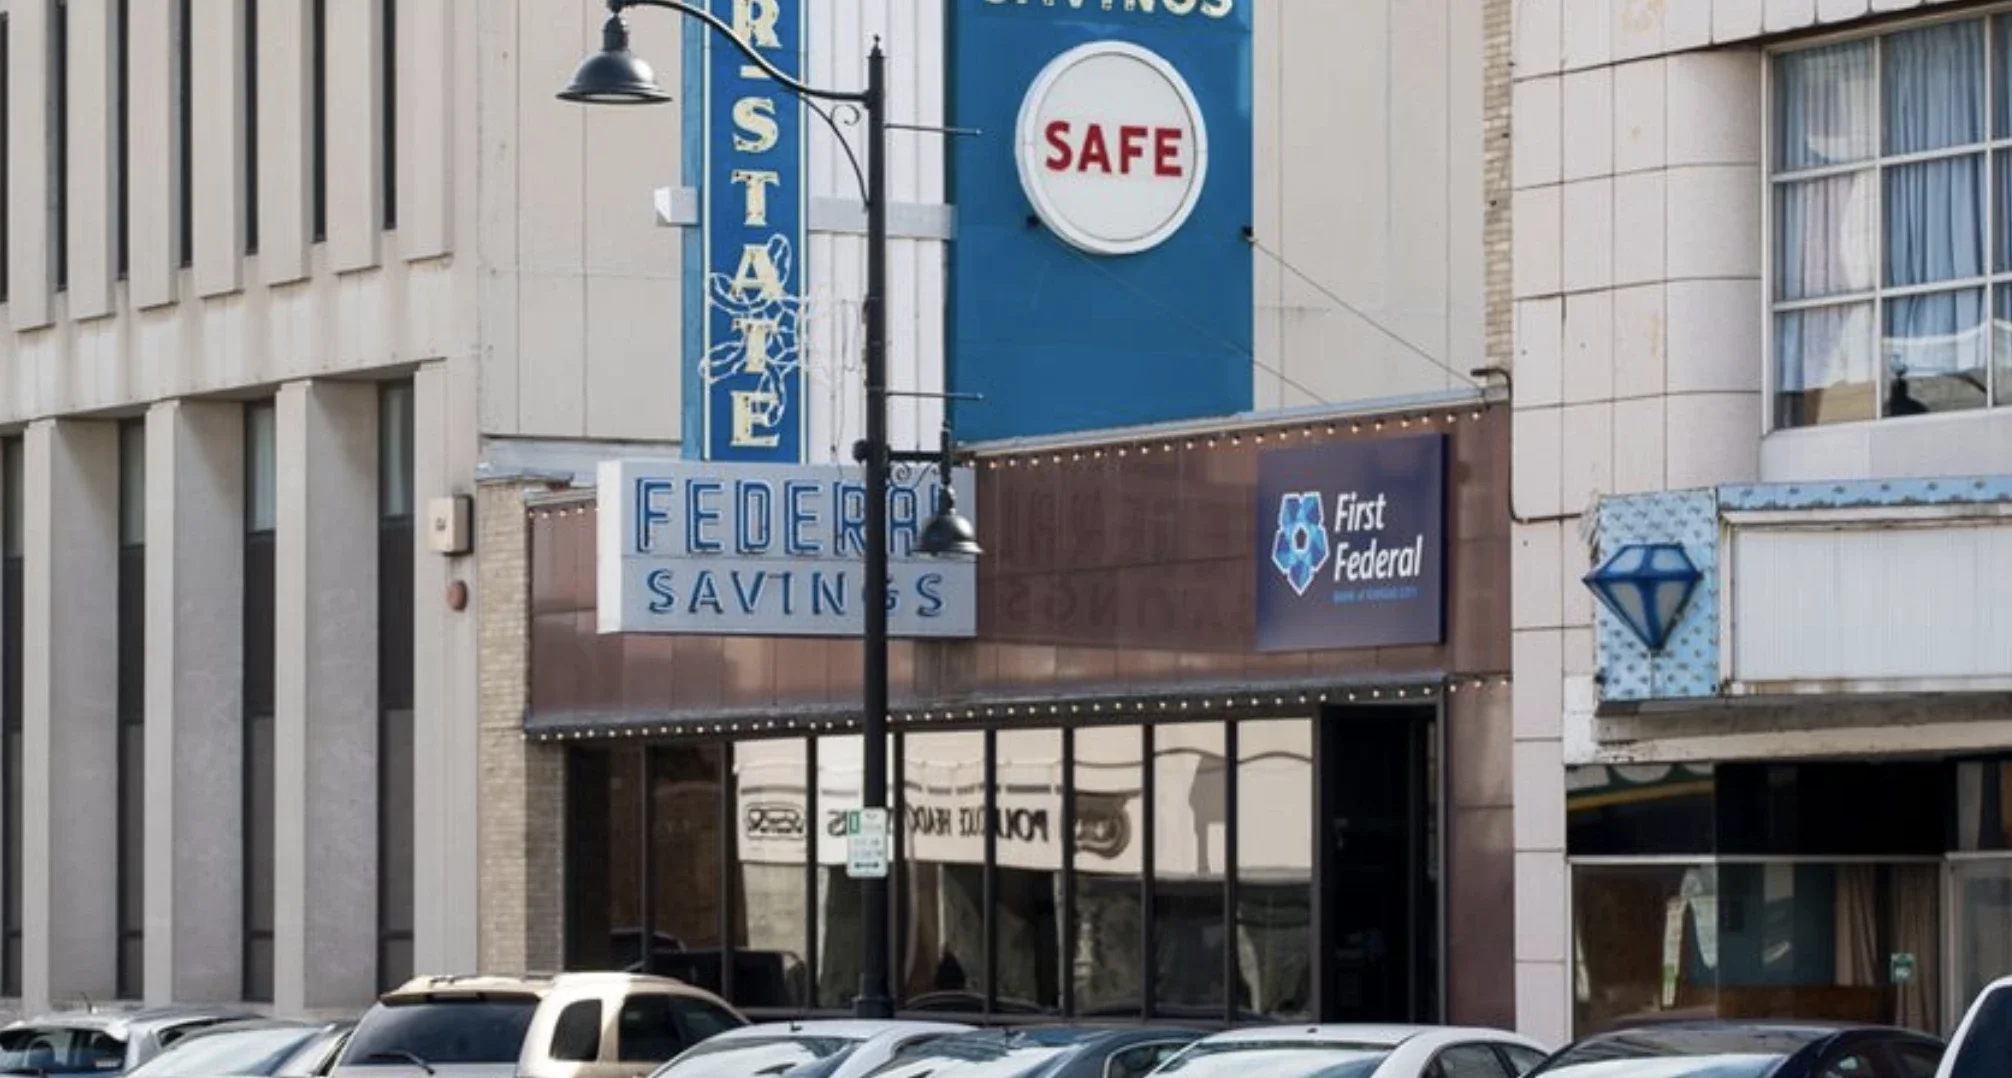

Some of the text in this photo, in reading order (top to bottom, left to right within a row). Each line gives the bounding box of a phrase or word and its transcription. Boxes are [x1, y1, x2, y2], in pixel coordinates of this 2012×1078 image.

[1045, 120, 1182, 177] SAFE
[1334, 491, 1386, 533] First
[1334, 534, 1423, 582] Federal
